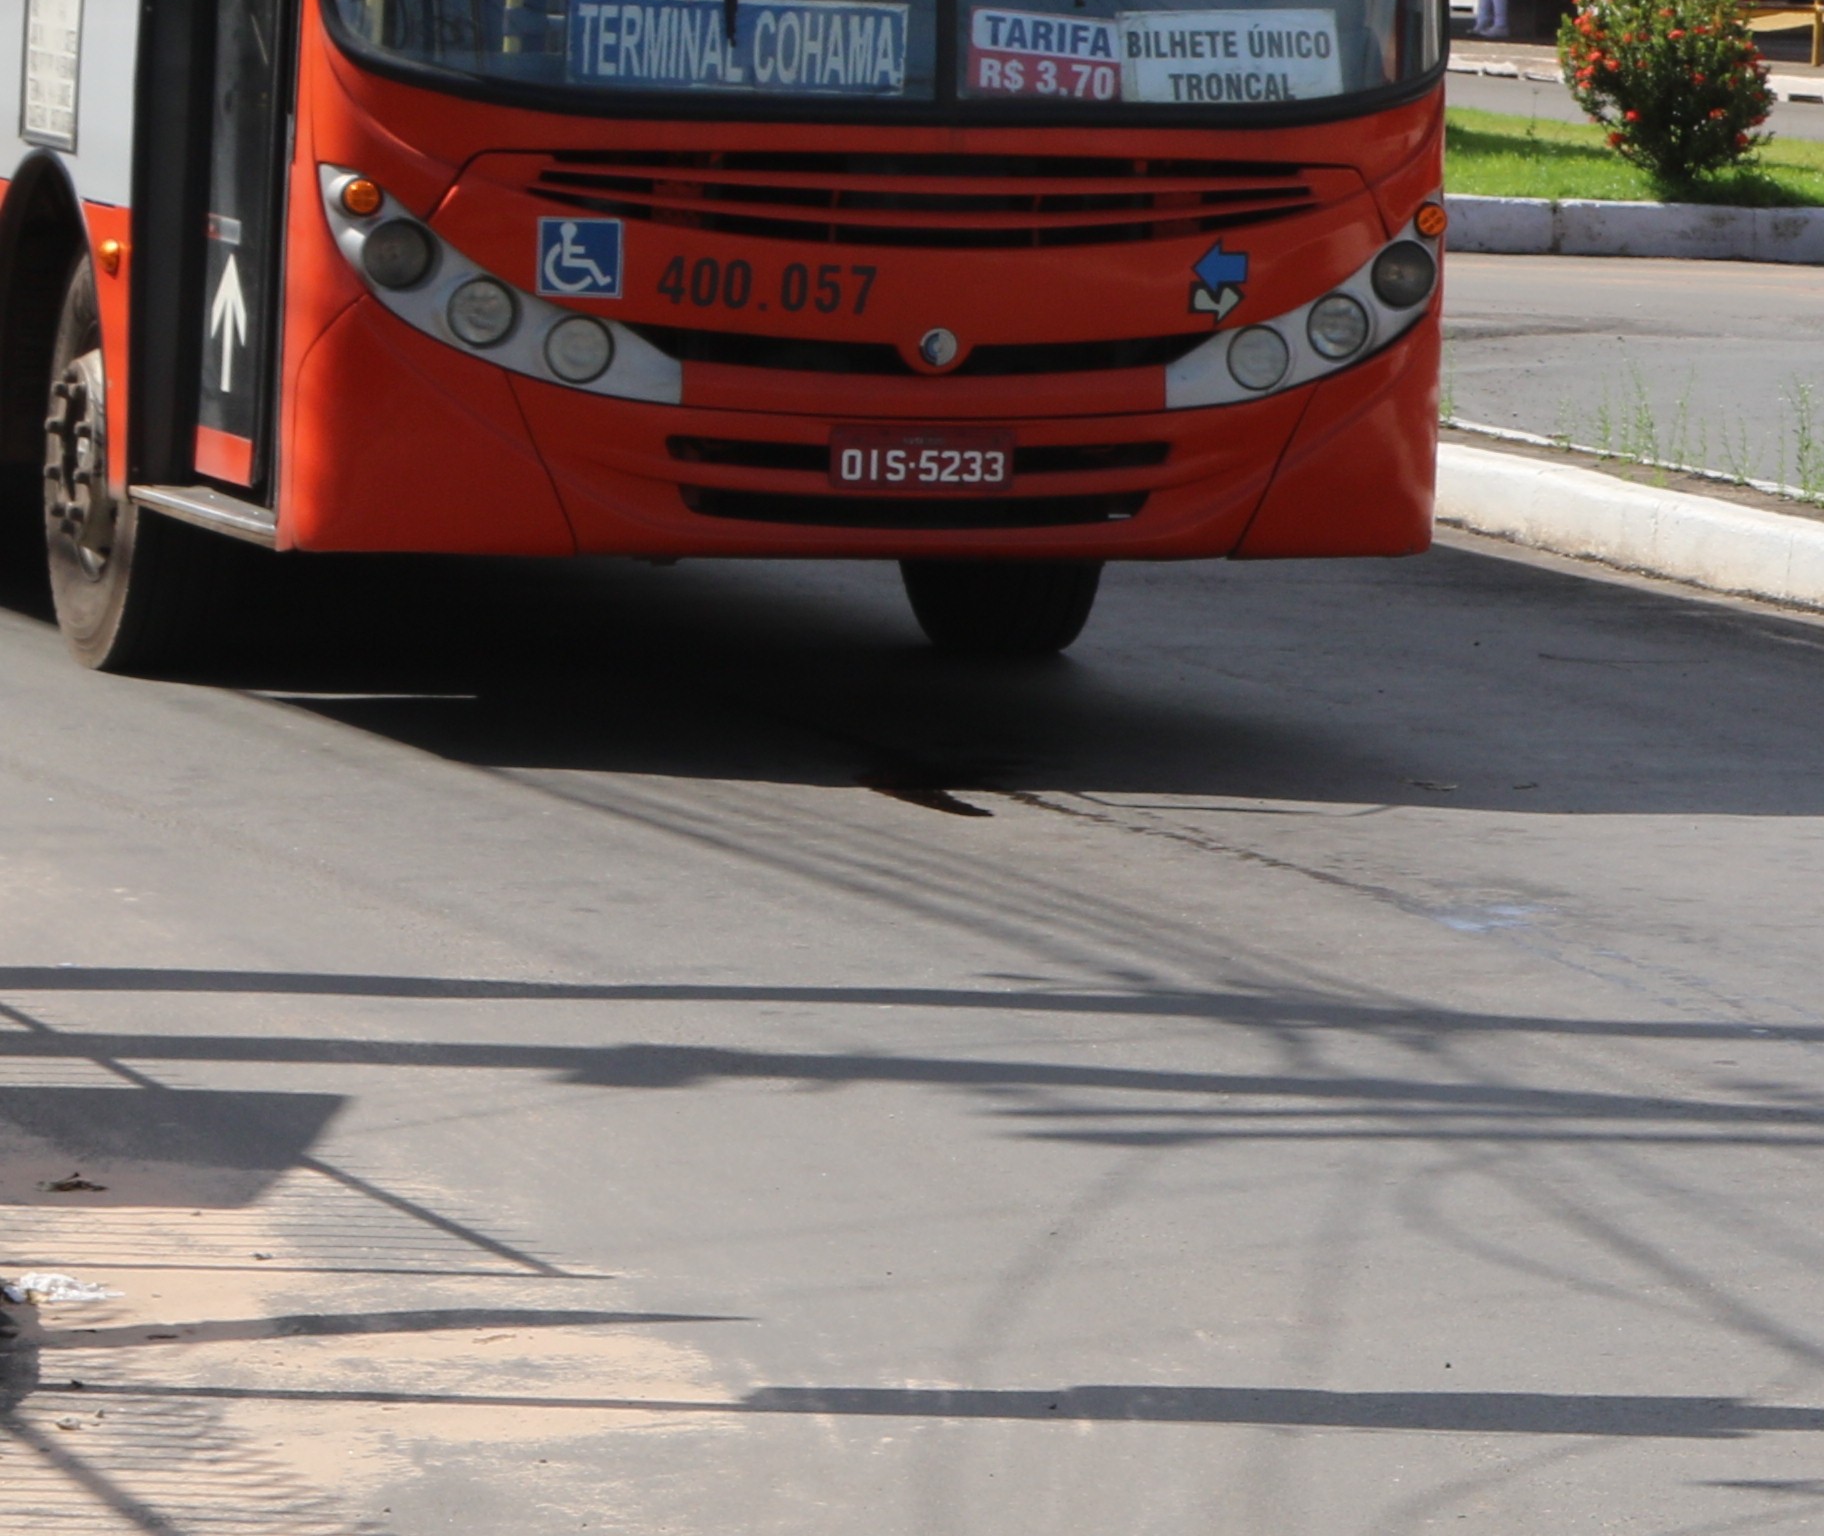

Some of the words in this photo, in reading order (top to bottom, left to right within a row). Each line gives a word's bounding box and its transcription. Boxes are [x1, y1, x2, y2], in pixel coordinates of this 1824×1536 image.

[578, 3, 743, 83] TERMINAL
[754, 11, 901, 85] COHAMA
[984, 15, 1113, 58] TARIFA
[1126, 30, 1238, 60] BILHETE
[1248, 23, 1331, 59] ÚNICO
[978, 58, 1025, 91] R$
[1036, 61, 1116, 101] 3.70
[1168, 72, 1296, 102] TRONCAL
[656, 255, 878, 317] 400.057
